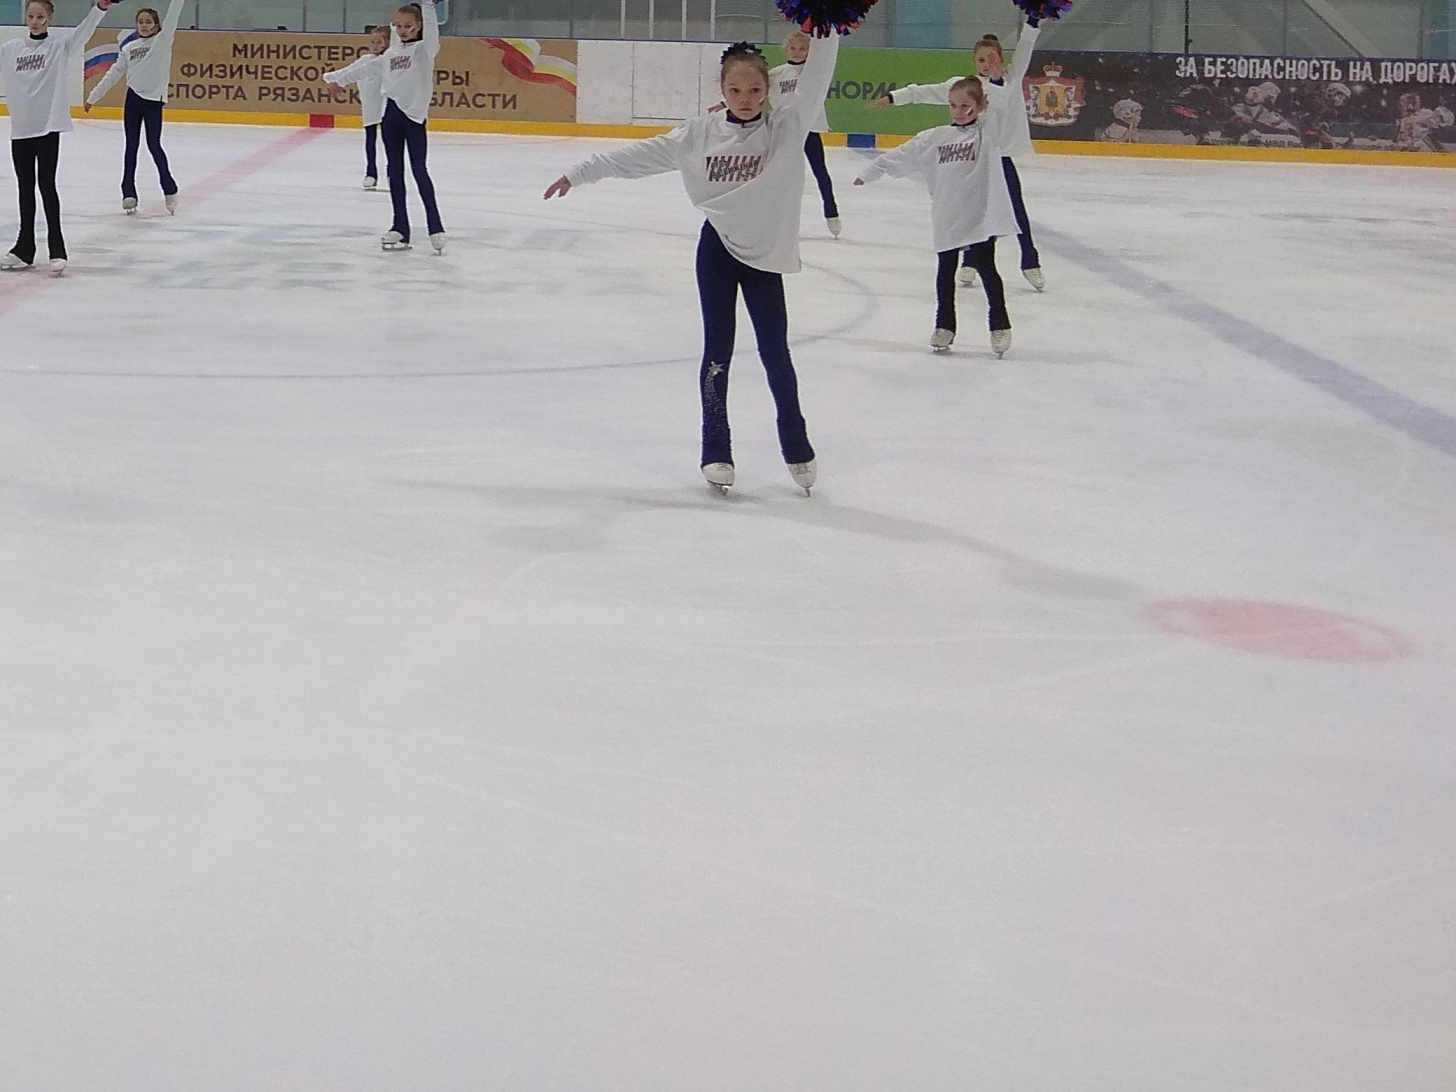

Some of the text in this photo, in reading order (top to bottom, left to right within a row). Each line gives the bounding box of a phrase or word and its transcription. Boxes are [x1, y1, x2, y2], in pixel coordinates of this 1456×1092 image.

[232, 43, 370, 61] МИНИСТЕРС
[1175, 57, 1198, 77] ЗА
[1204, 57, 1342, 81] БЕЗОПАСНОСТЬ
[1348, 61, 1374, 82] НА
[258, 85, 362, 104] РЯЗАНСК
[429, 91, 518, 109] БЛАСТИ
[827, 81, 897, 100] НОРМ
